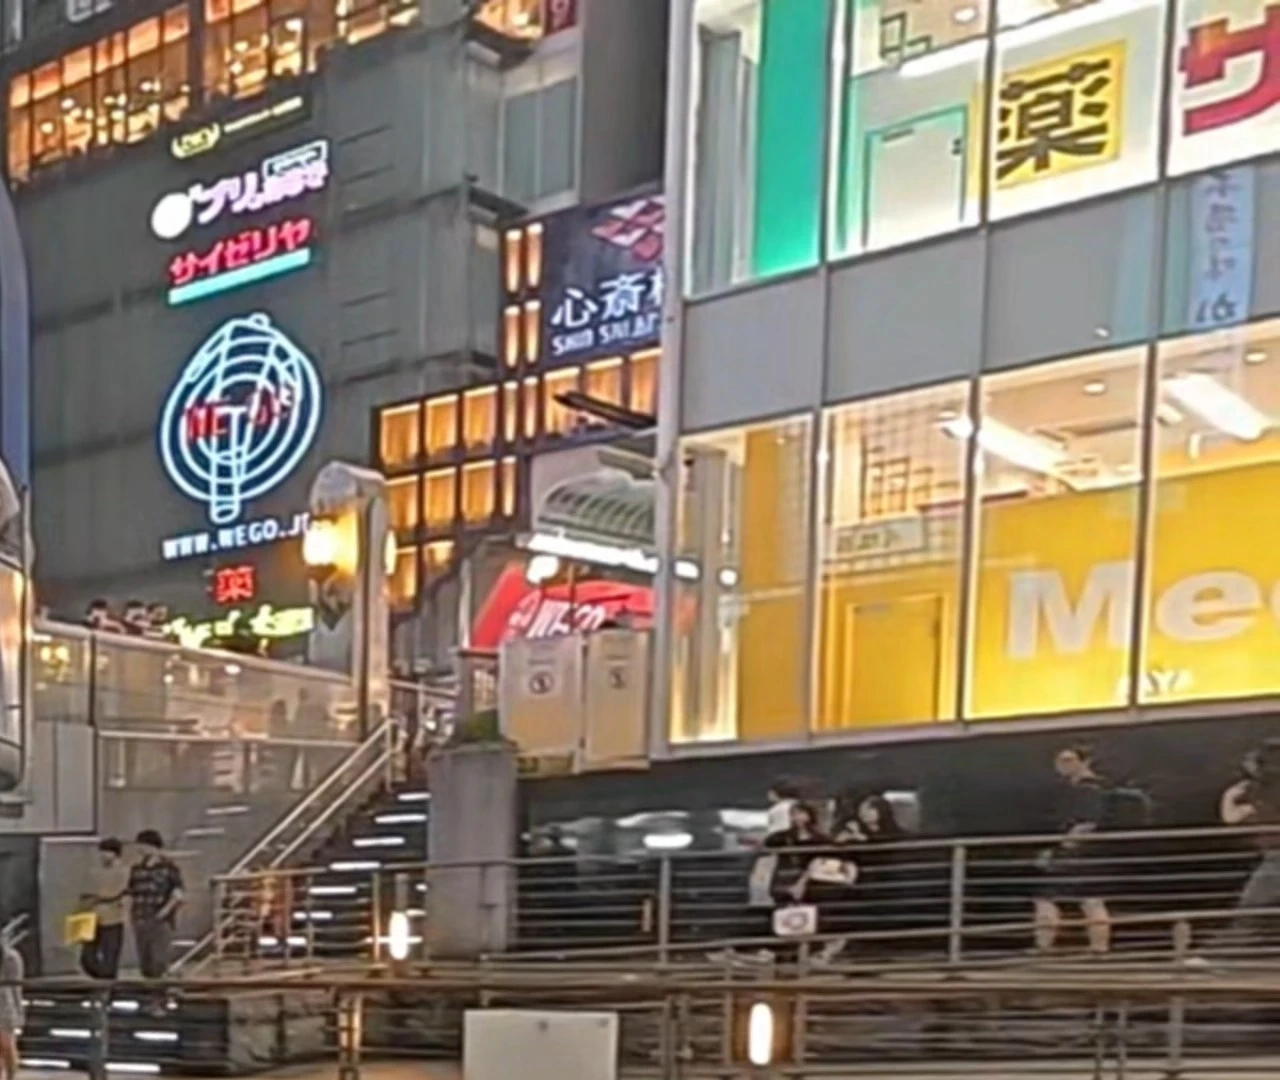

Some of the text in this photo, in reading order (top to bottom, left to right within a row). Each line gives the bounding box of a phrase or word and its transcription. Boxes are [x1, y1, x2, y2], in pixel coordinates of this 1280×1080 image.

[996, 58, 1111, 181] 薬
[169, 218, 311, 285] サイゼリヤ
[1006, 555, 1280, 661] Me
